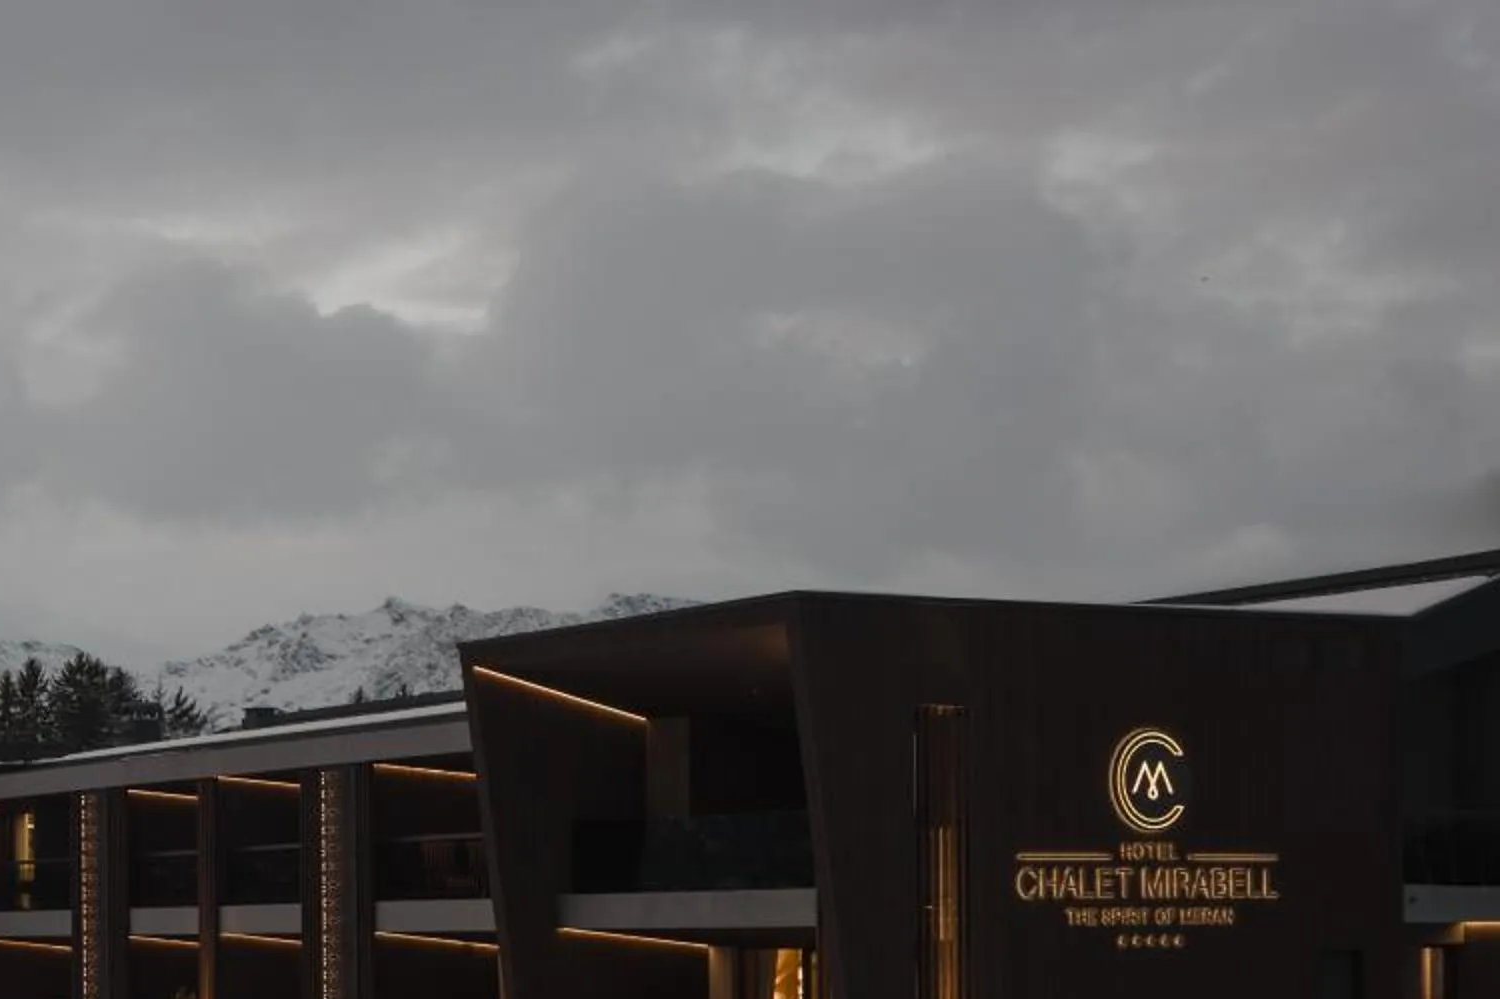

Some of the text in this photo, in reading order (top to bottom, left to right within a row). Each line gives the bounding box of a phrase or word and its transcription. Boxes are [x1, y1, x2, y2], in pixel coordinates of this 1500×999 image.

[1120, 842, 1180, 860] HOTEL
[1016, 867, 1280, 900] CHALET MIRABELL
[1065, 908, 1097, 926] THE
